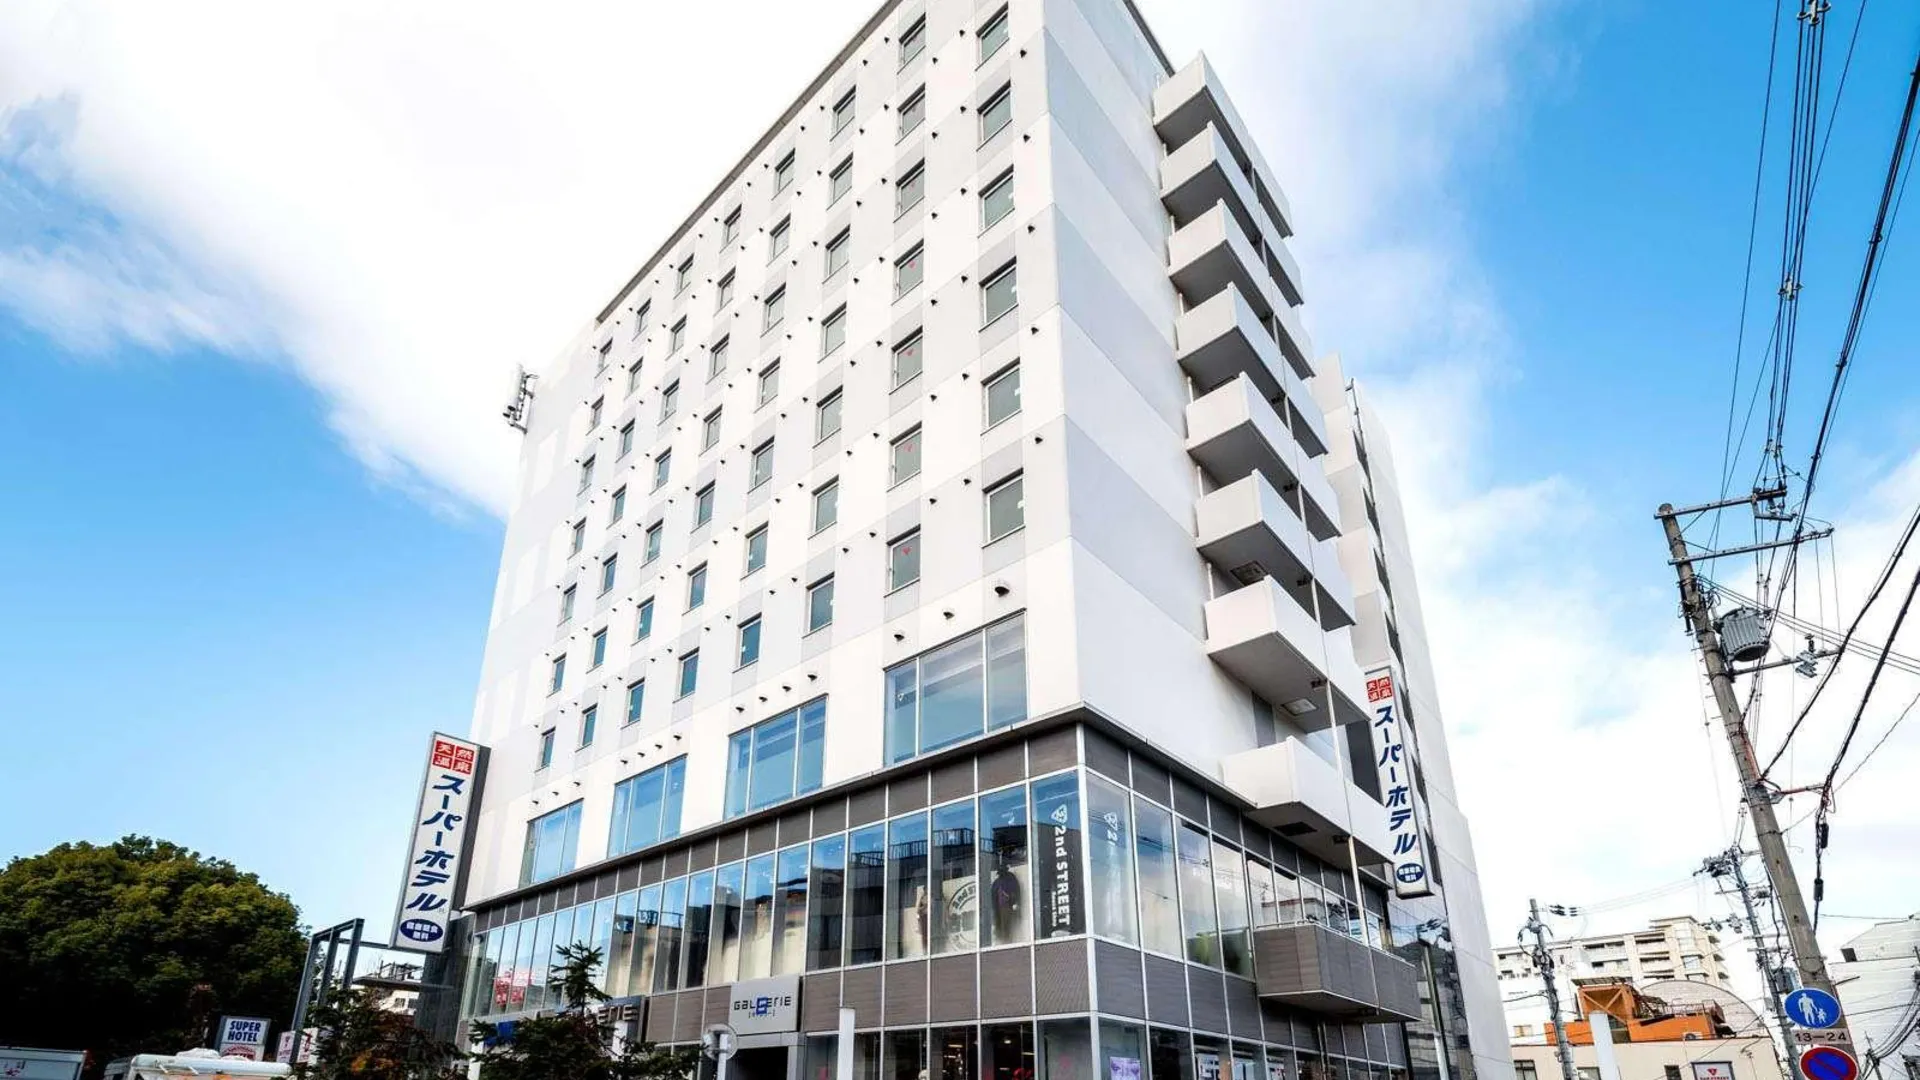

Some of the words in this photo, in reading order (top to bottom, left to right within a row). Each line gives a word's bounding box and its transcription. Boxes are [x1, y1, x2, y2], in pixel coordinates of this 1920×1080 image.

[1375, 705, 1417, 855] スーパーホテル
[405, 774, 465, 911] スーパーホテル
[1055, 826, 1068, 858] 2nd
[1056, 861, 1071, 925] STREET
[227, 1030, 258, 1042] HOTEL
[230, 1020, 262, 1032] SUPER
